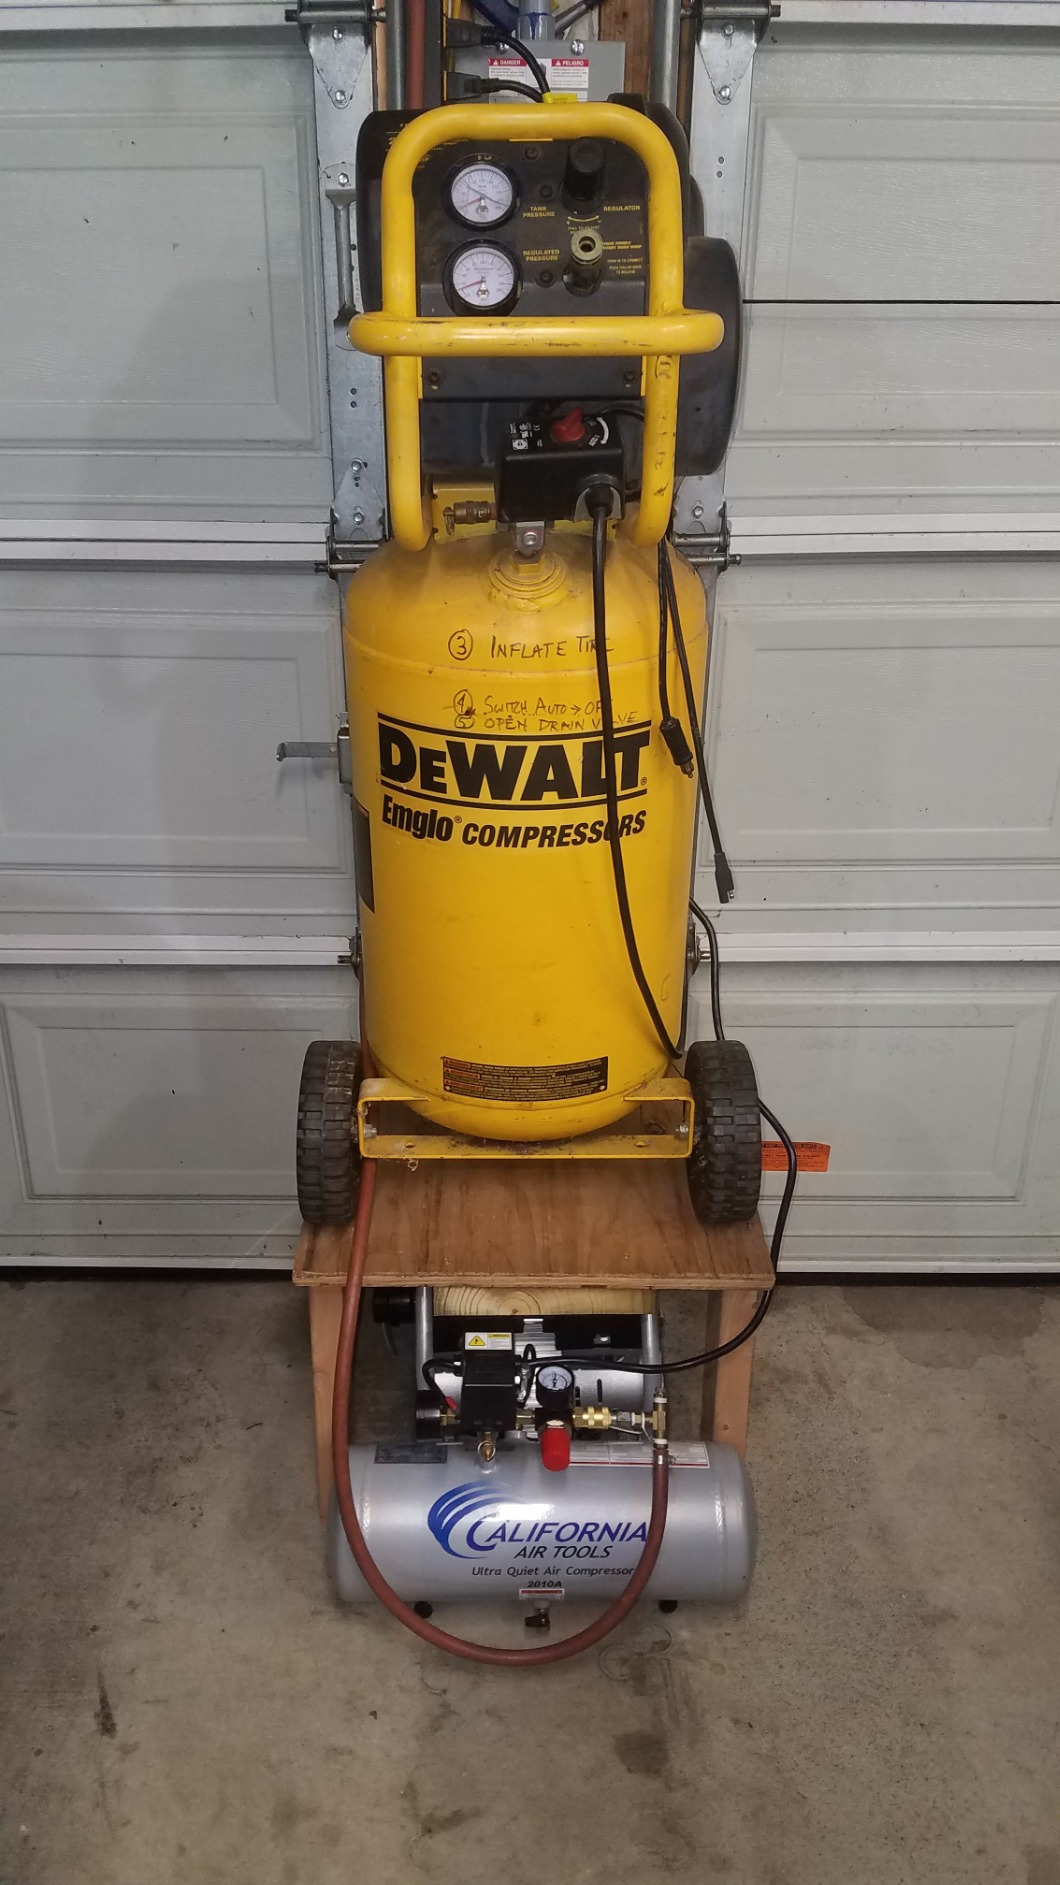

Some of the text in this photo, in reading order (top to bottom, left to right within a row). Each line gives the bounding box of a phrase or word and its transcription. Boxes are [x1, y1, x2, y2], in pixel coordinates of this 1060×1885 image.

[491, 635, 568, 659] INFLATE
[484, 695, 528, 715] SWITCH
[535, 697, 567, 716] AUTO
[484, 717, 528, 732] OPEN
[538, 718, 585, 732] DRAIN
[591, 711, 638, 730] VVE
[466, 1511, 648, 1552] CALIFORNIA
[513, 1545, 614, 1559] AIR TOOLS
[472, 1565, 635, 1578] Ultra Quiet Air Compressor
[527, 1580, 562, 1588] 2010A
